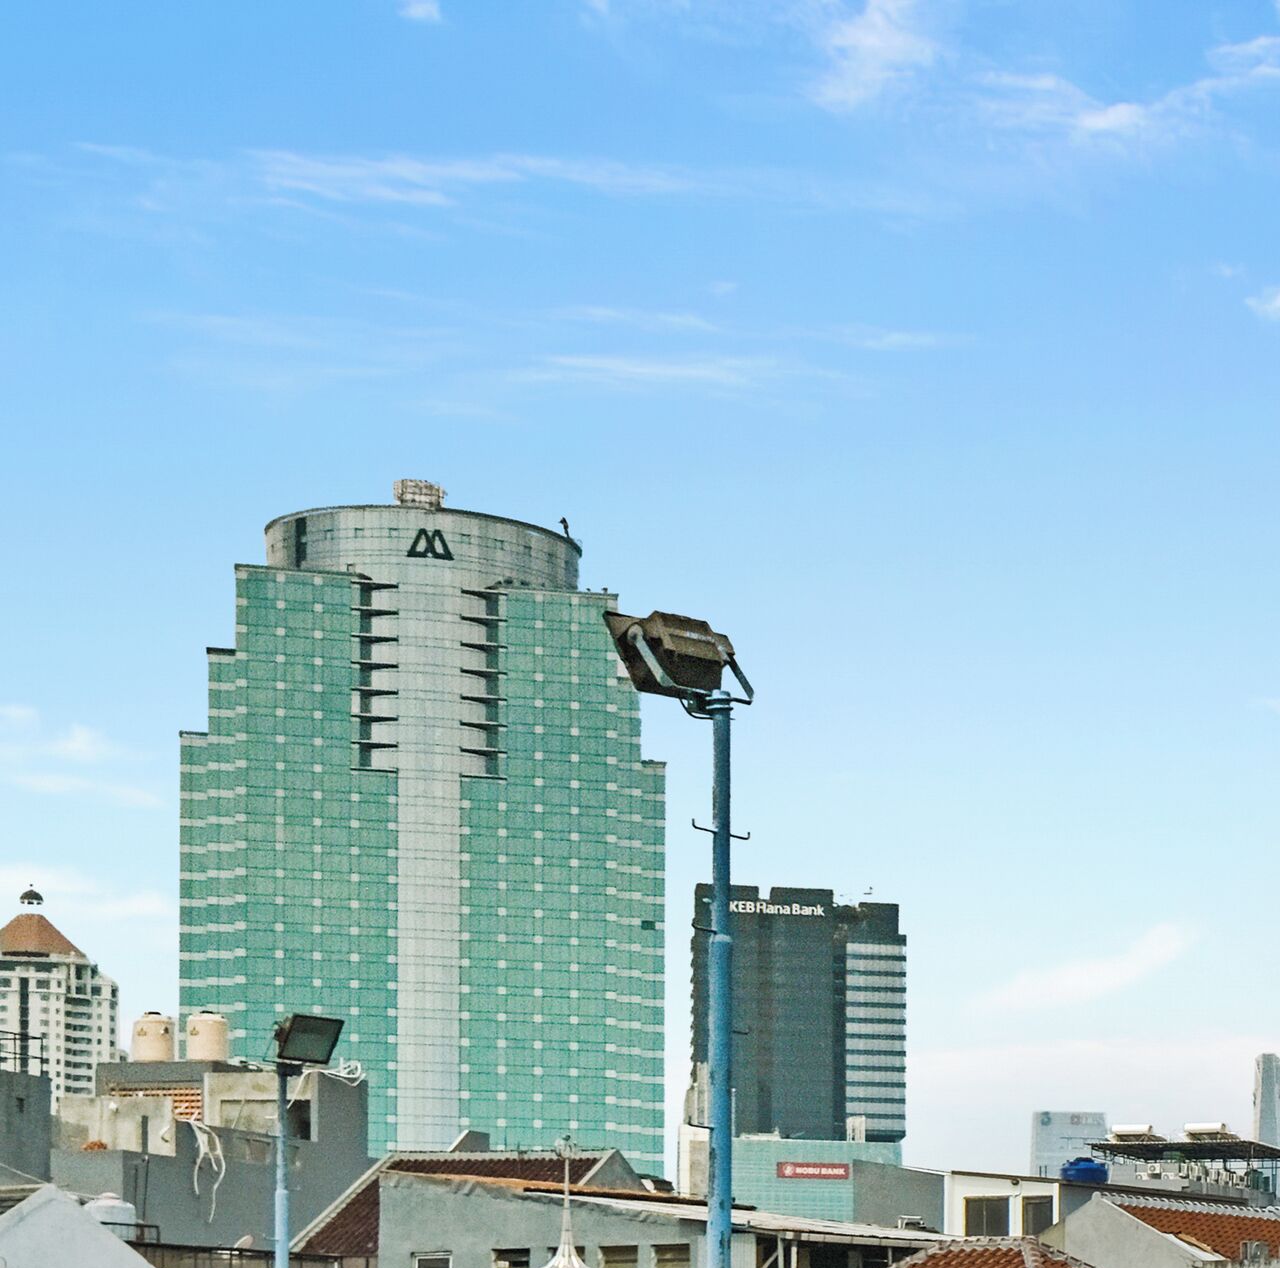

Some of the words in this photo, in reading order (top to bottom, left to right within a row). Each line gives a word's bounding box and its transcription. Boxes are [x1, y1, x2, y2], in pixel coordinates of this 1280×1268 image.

[729, 901, 755, 913] KEB
[756, 902, 790, 915] Hana
[792, 904, 825, 916] Bank
[821, 1167, 846, 1175] BANK
